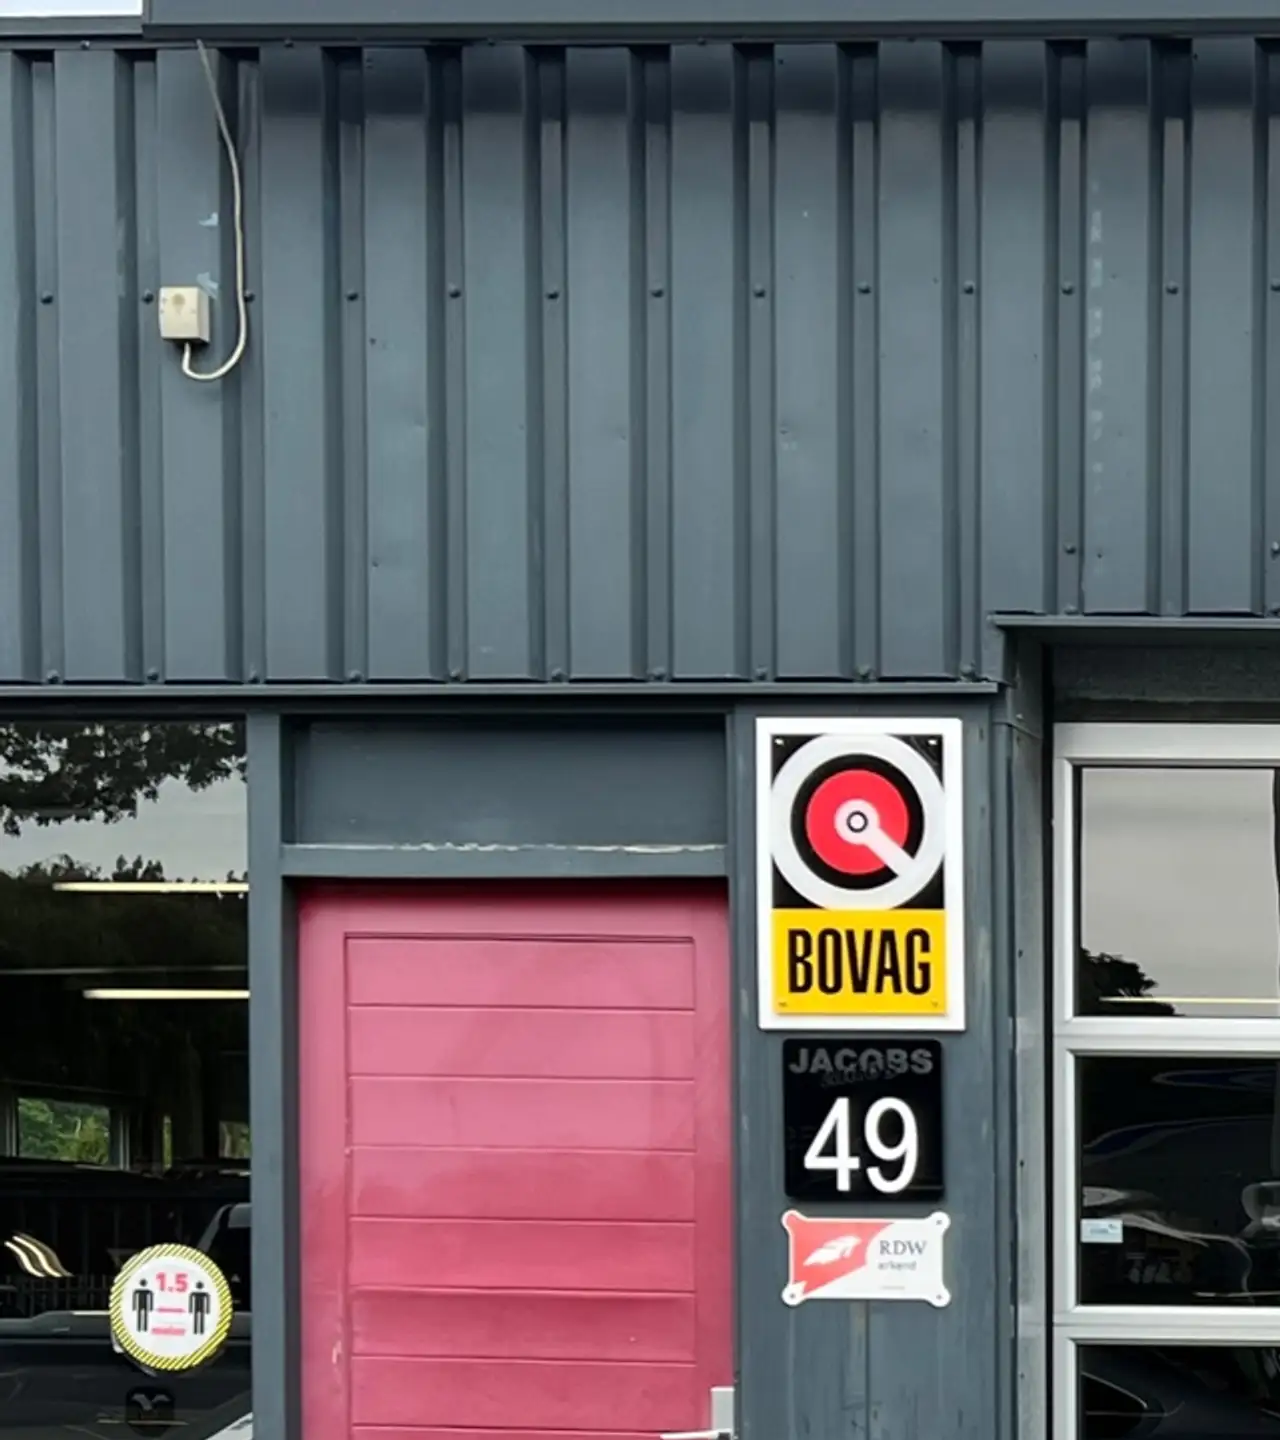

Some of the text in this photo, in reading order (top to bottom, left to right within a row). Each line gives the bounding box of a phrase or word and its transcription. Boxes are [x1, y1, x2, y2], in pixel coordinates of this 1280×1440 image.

[786, 927, 931, 995] BOVAG
[788, 1048, 934, 1074] JACOBS
[803, 1096, 918, 1193] 49
[879, 1239, 928, 1256] RDW
[155, 1271, 189, 1293] 1.5
